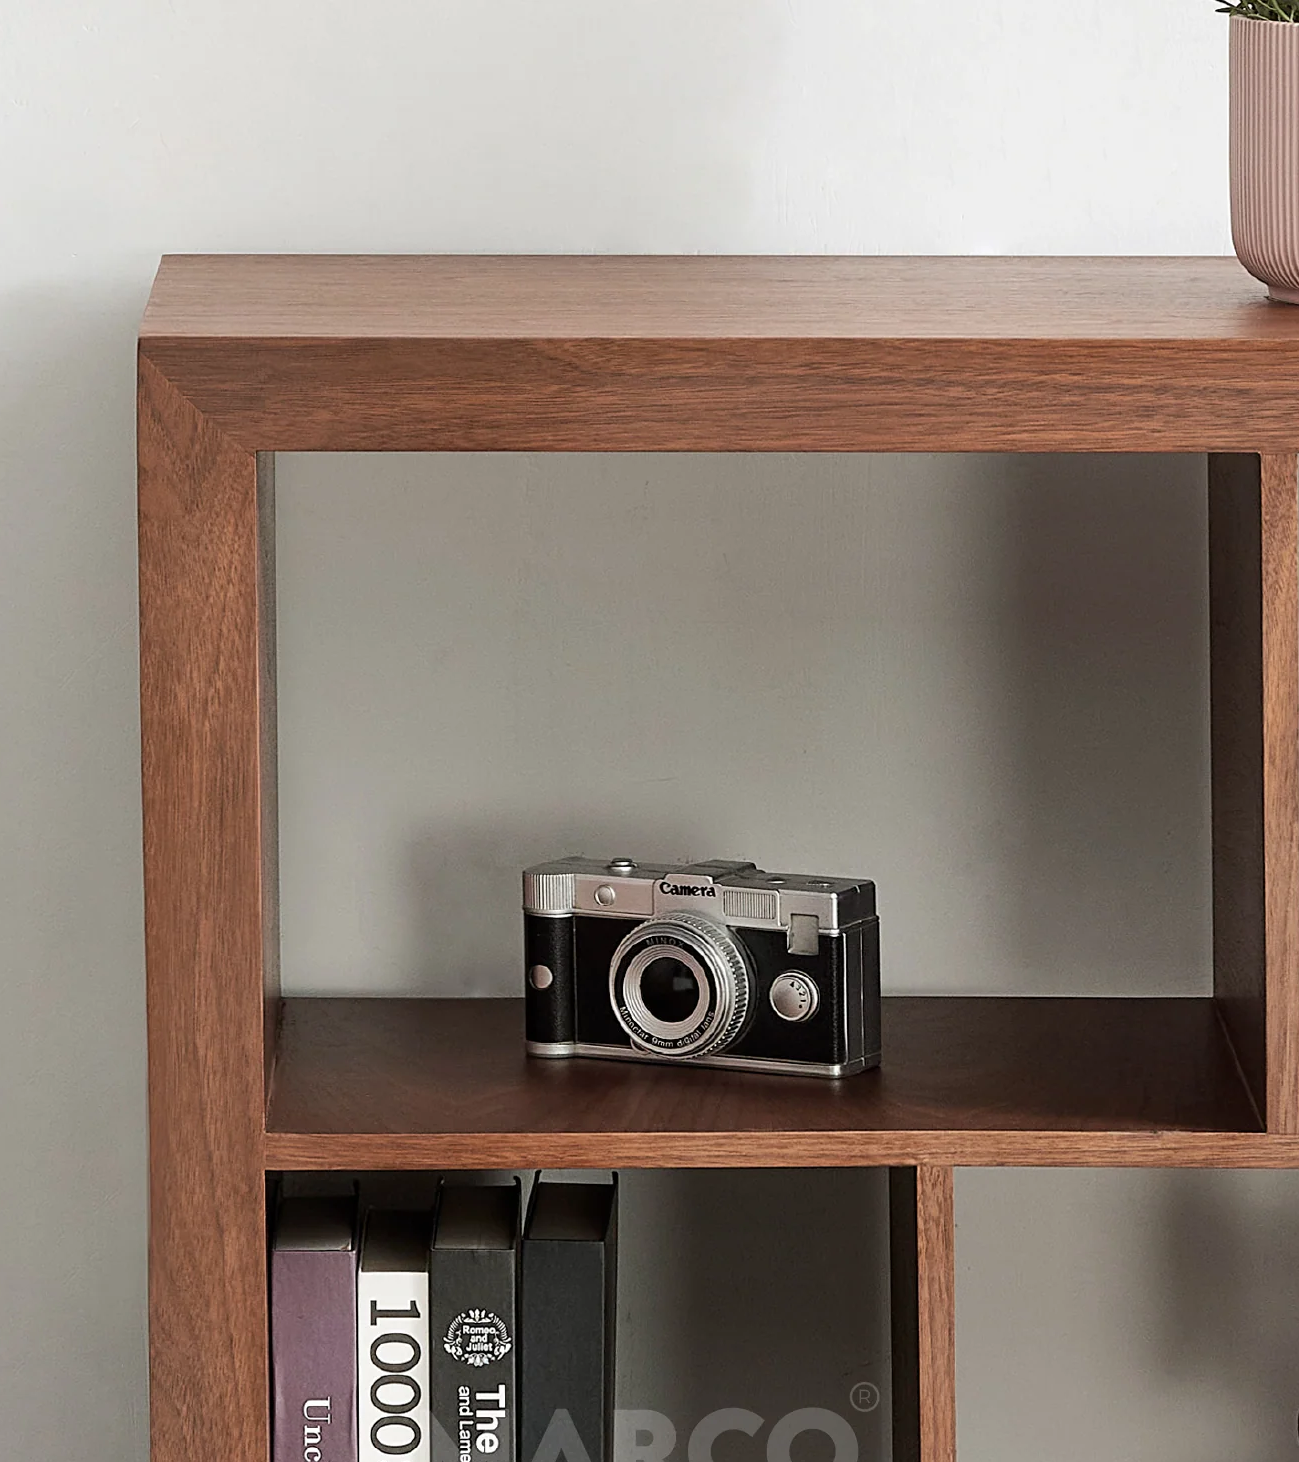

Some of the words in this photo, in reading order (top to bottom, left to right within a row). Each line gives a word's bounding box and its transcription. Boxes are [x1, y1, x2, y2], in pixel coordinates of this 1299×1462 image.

[659, 881, 716, 898] Camera
[462, 1325, 496, 1334] Romeo
[465, 1342, 493, 1352] Juliet
[470, 1334, 488, 1343] and
[369, 1299, 422, 1456] 1000
[458, 1386, 474, 1416] and
[475, 1384, 507, 1454] The
